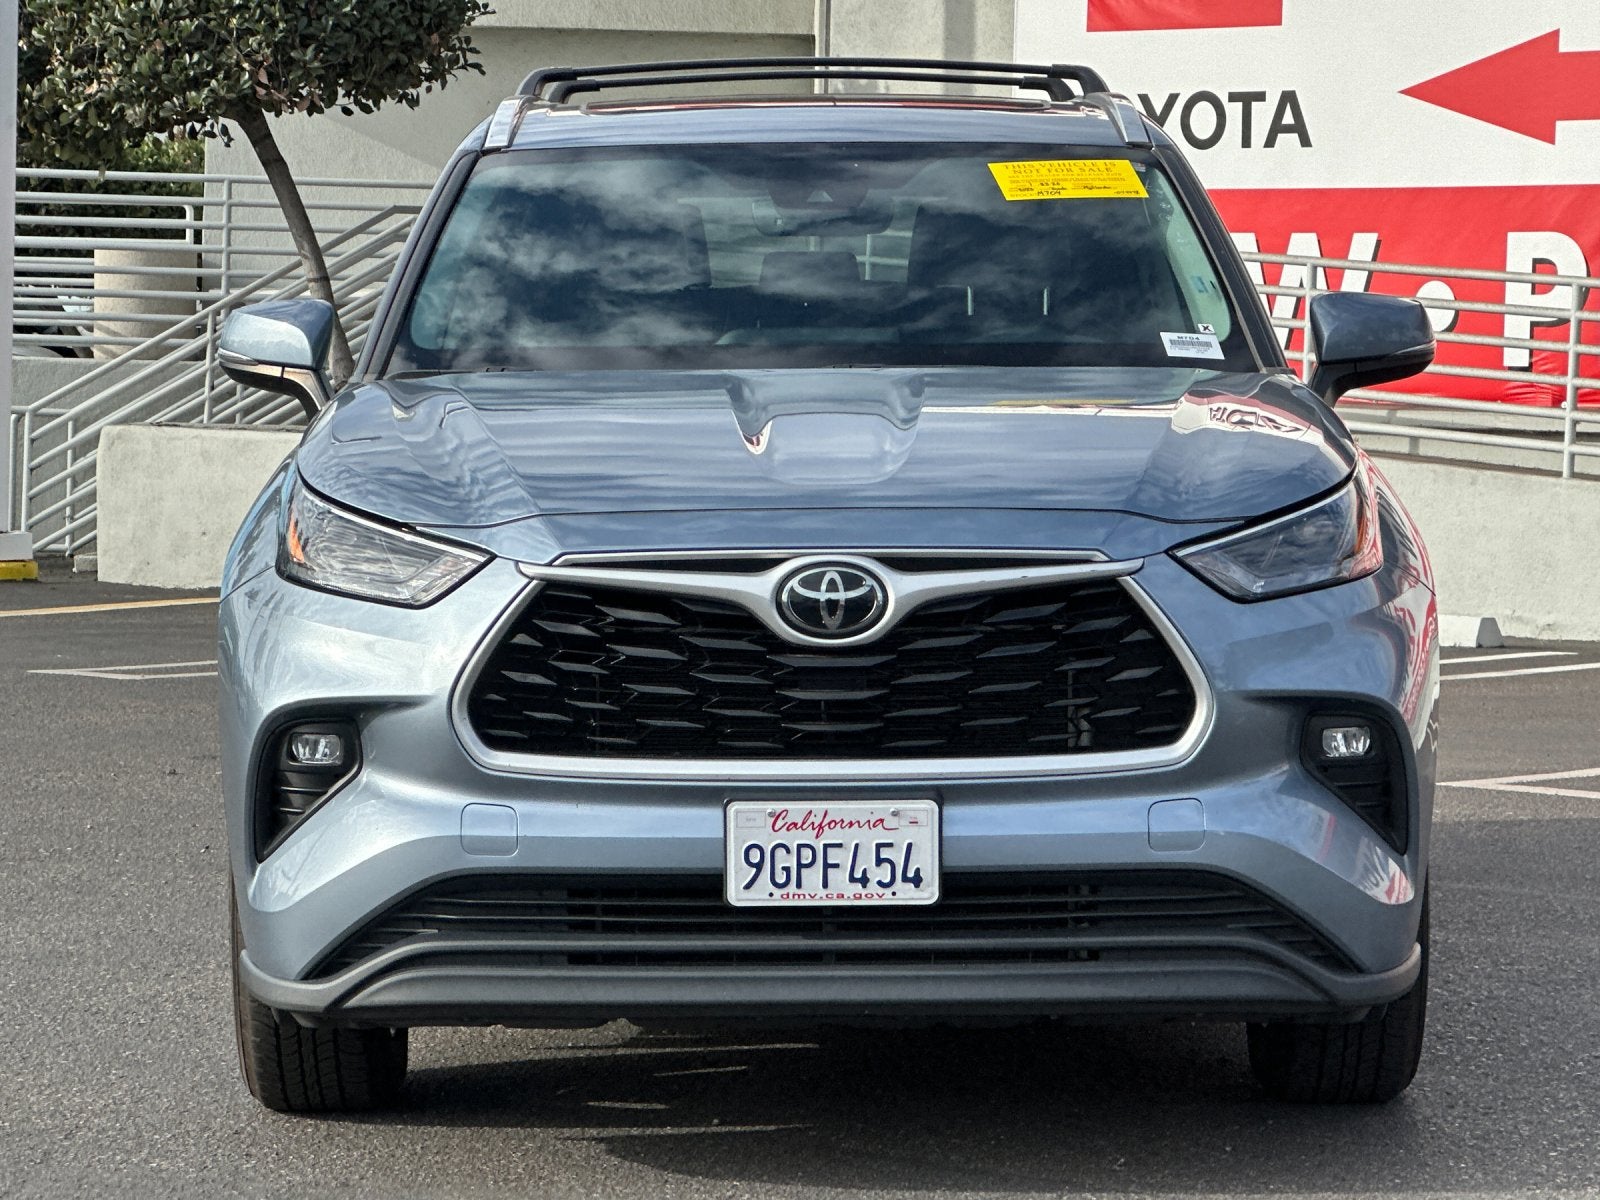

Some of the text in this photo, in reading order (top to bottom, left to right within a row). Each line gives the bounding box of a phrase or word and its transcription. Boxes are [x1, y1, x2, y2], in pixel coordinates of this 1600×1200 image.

[1137, 90, 1313, 150] YOTA
[771, 809, 899, 839] California
[742, 842, 924, 890] 9GPF454
[780, 891, 886, 900] dmv.ca.gov
